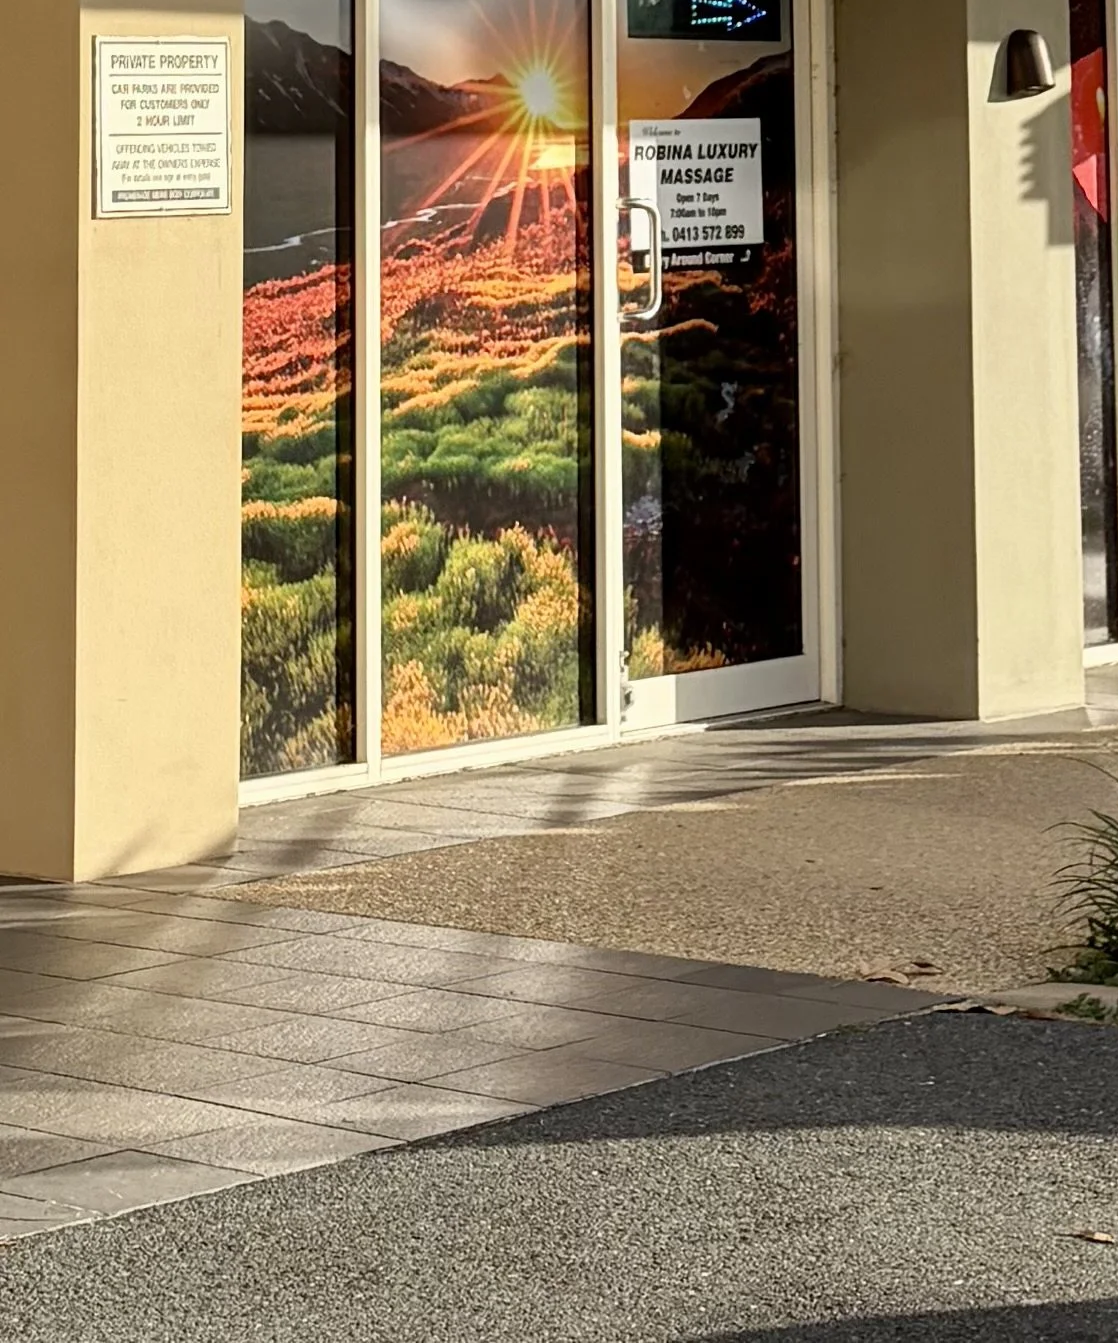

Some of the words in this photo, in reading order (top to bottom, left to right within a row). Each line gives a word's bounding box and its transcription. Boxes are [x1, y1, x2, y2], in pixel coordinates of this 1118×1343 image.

[111, 54, 156, 69] PRIVATE
[160, 54, 218, 69] PROPERTY
[112, 84, 128, 94] CAR
[132, 84, 158, 94] PARKS
[161, 84, 177, 94] ARE
[180, 84, 219, 94] PROVIDED
[121, 100, 136, 110] FOR
[140, 99, 188, 110] CUSTOMERS
[190, 99, 210, 110] ONLY
[136, 116, 142, 126] 2
[145, 116, 170, 126] HOUR
[173, 115, 195, 126] LIMIT
[634, 144, 692, 161] ROBINA
[698, 143, 758, 159] LUXURY
[660, 168, 734, 185] MASSAGE
[676, 193, 694, 204] Open
[696, 193, 701, 202] 7
[703, 192, 719, 204] Days
[698, 208, 706, 217] to
[708, 207, 727, 218] 10pm
[672, 227, 700, 242] 0413
[702, 226, 722, 240] 572
[725, 224, 745, 239] 899
[671, 253, 703, 266] Around
[705, 251, 734, 265] Corner
